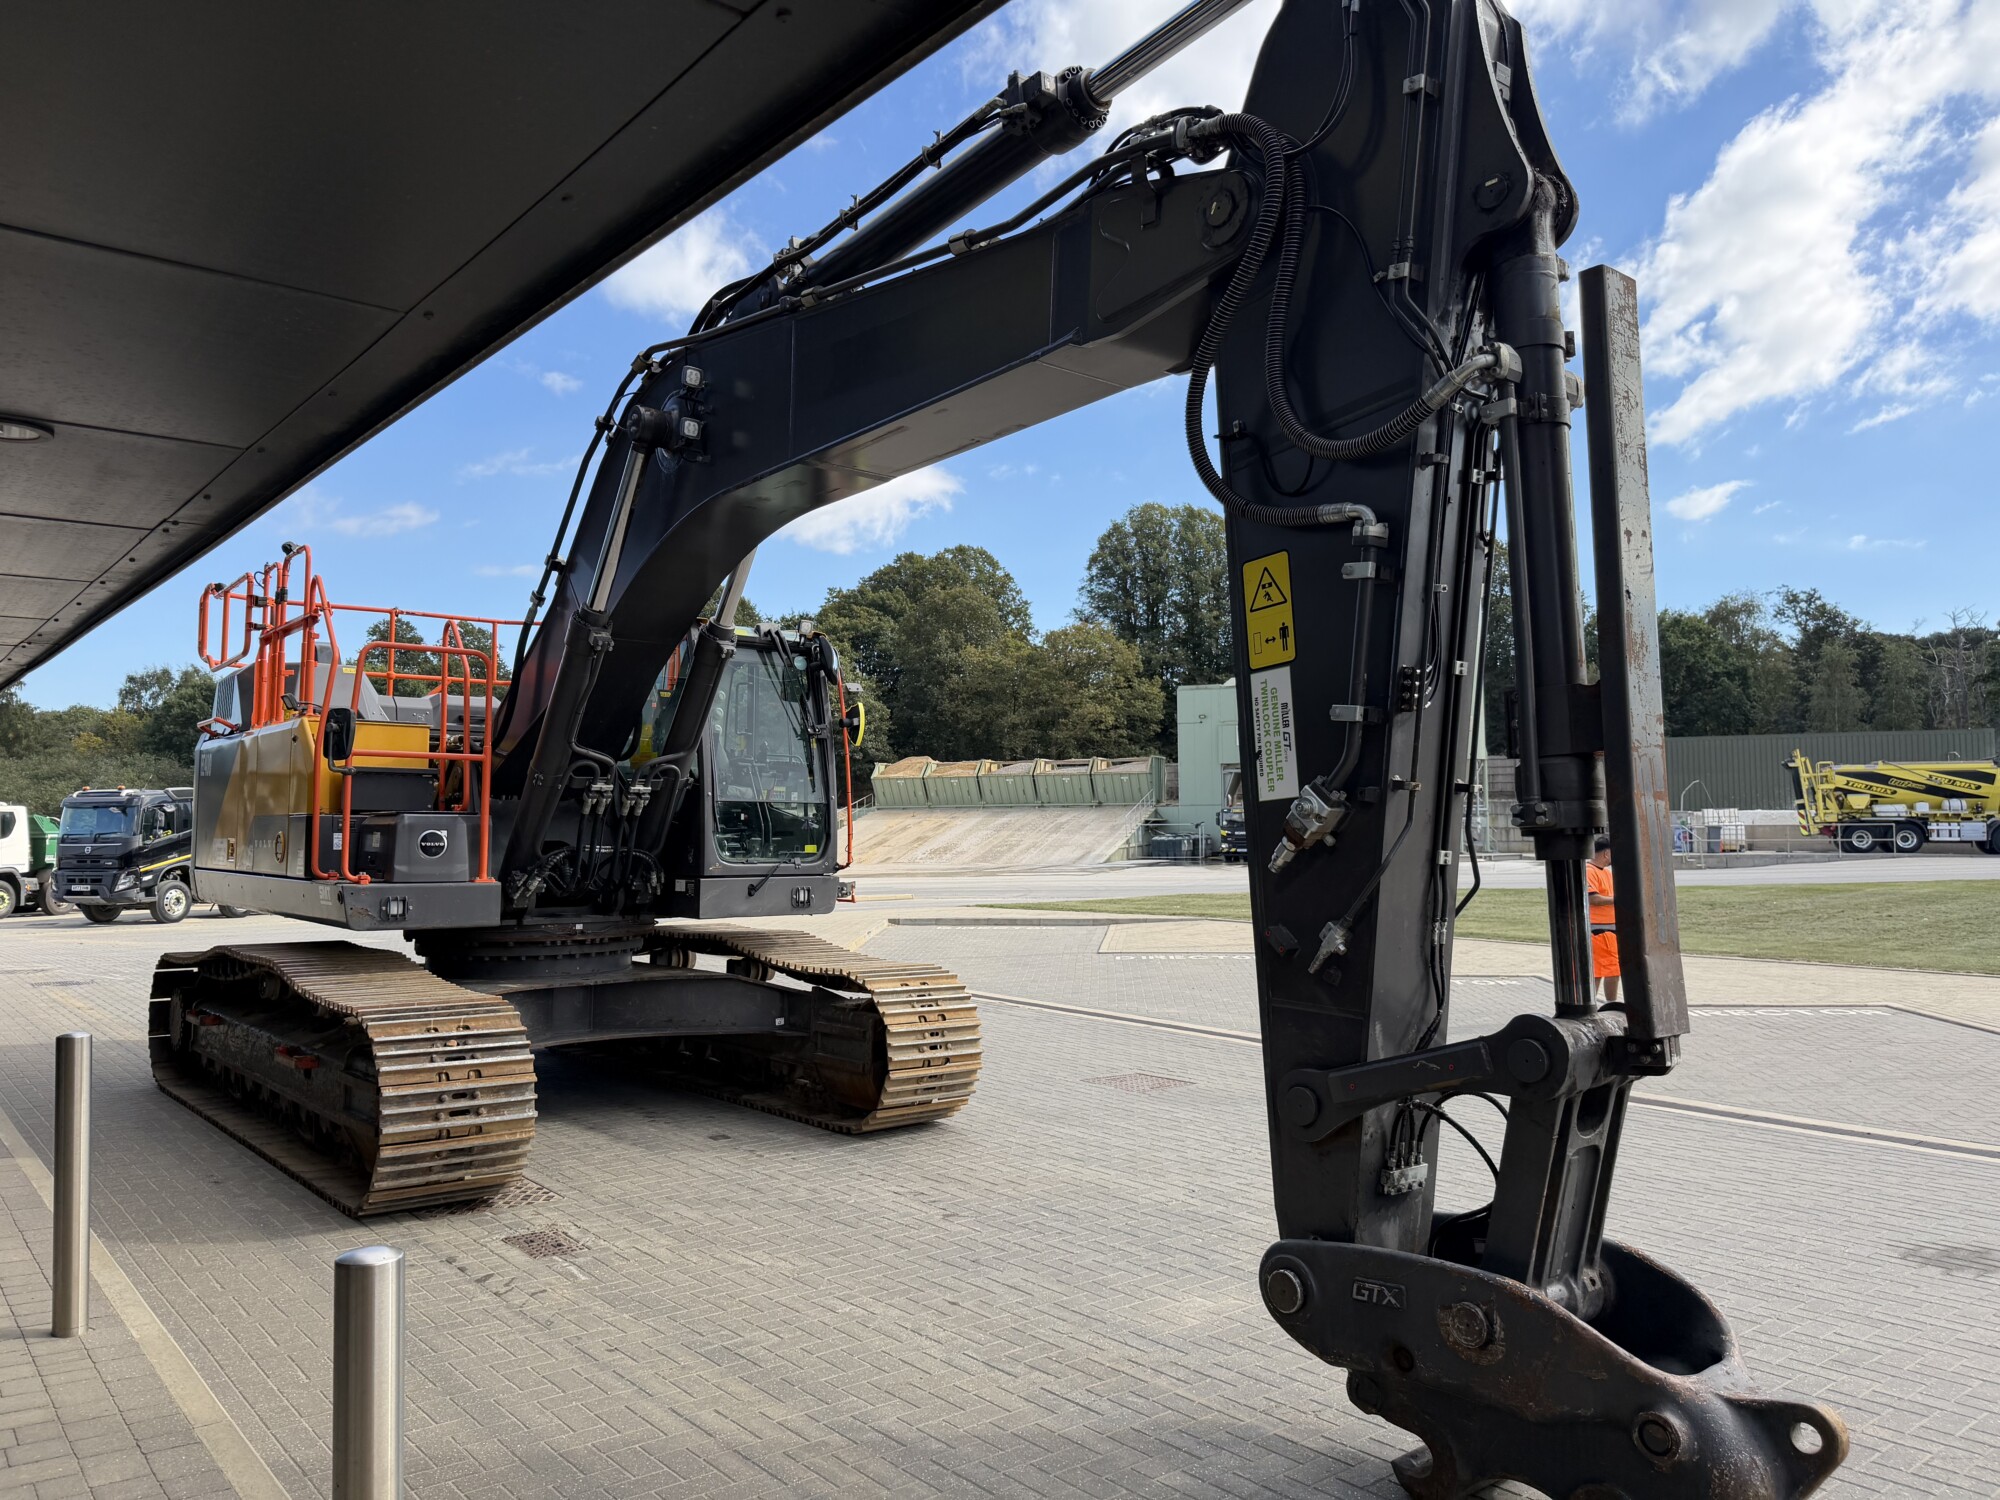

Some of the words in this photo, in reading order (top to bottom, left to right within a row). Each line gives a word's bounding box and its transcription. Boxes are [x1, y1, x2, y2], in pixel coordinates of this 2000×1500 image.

[1254, 697, 1259, 707] NO
[1260, 678, 1272, 738] TWINLOCK
[1270, 687, 1281, 738] GENUINE
[1282, 731, 1292, 752] GT
[1264, 741, 1275, 793] COUPLER
[1274, 740, 1284, 782] MILLER
[1688, 1008, 1892, 1017] IRECTOR
[1352, 1281, 1400, 1308] GTX
